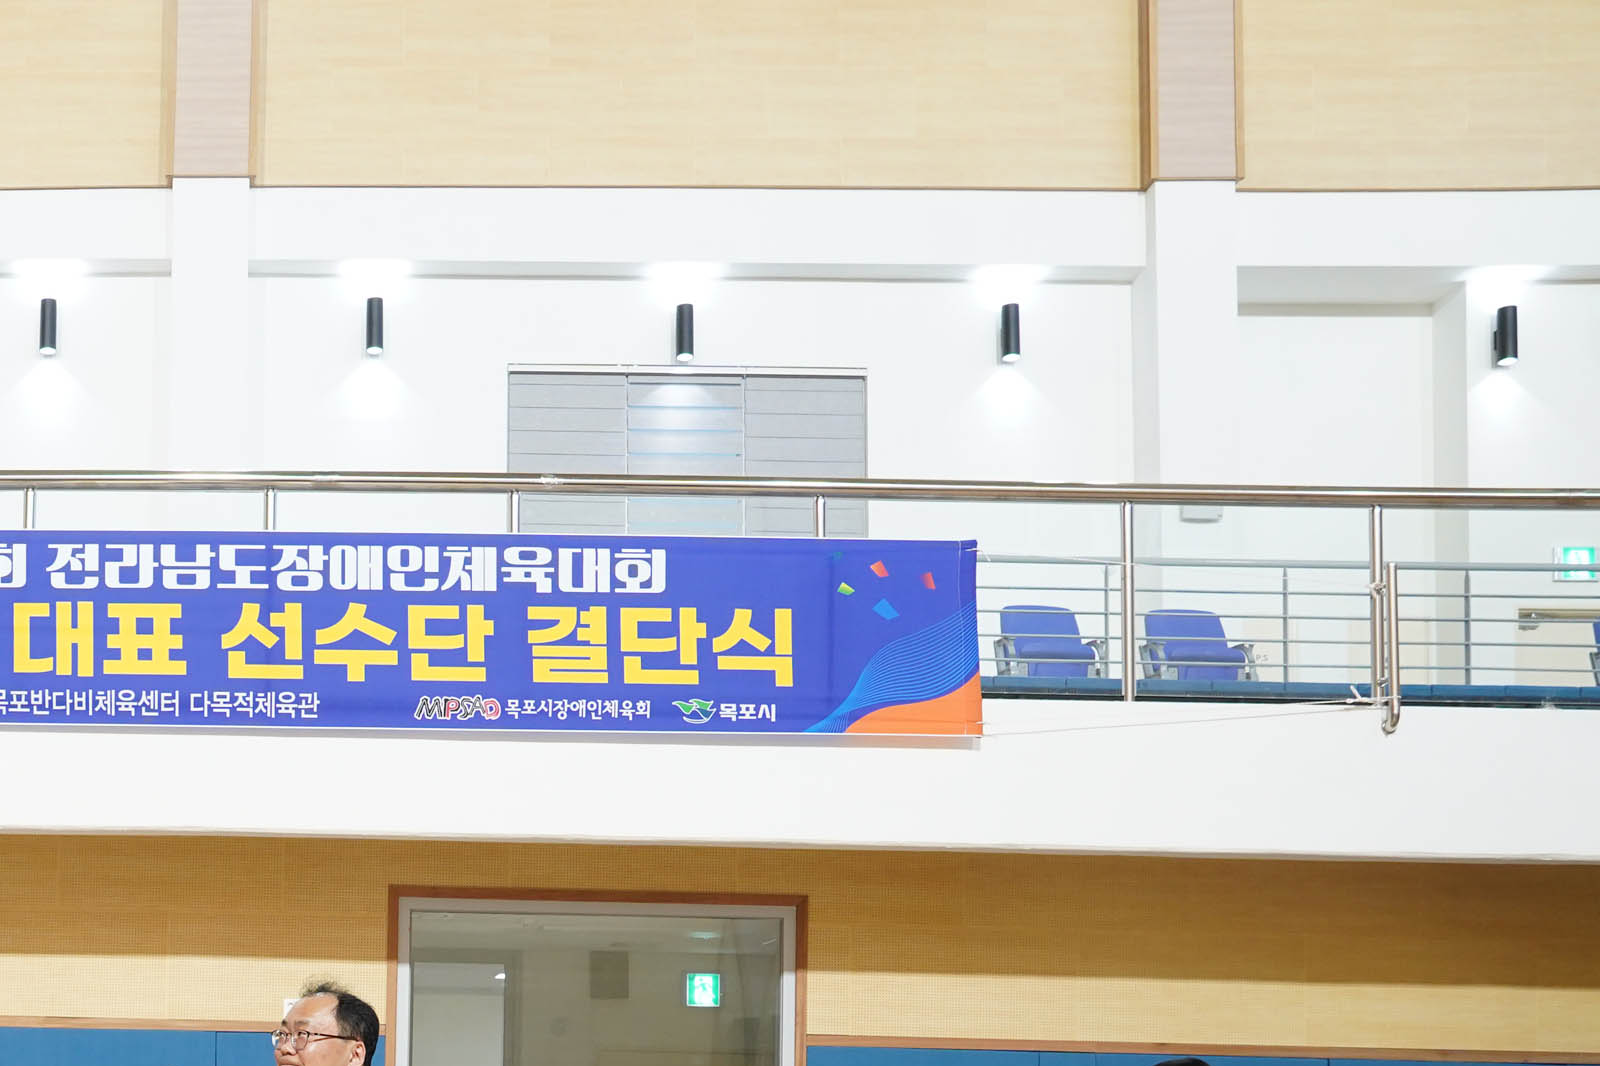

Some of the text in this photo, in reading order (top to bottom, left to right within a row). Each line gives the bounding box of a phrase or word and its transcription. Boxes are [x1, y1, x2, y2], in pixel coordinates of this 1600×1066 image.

[45, 543, 667, 595] 전라남도장애인체육대회
[12, 600, 188, 677] 대표
[220, 602, 495, 683] 선수단
[526, 606, 795, 688] 결단식
[189, 690, 321, 719] 다목적체육관
[504, 699, 652, 721] 목포시장애인체육회
[719, 702, 777, 723] 목포시
